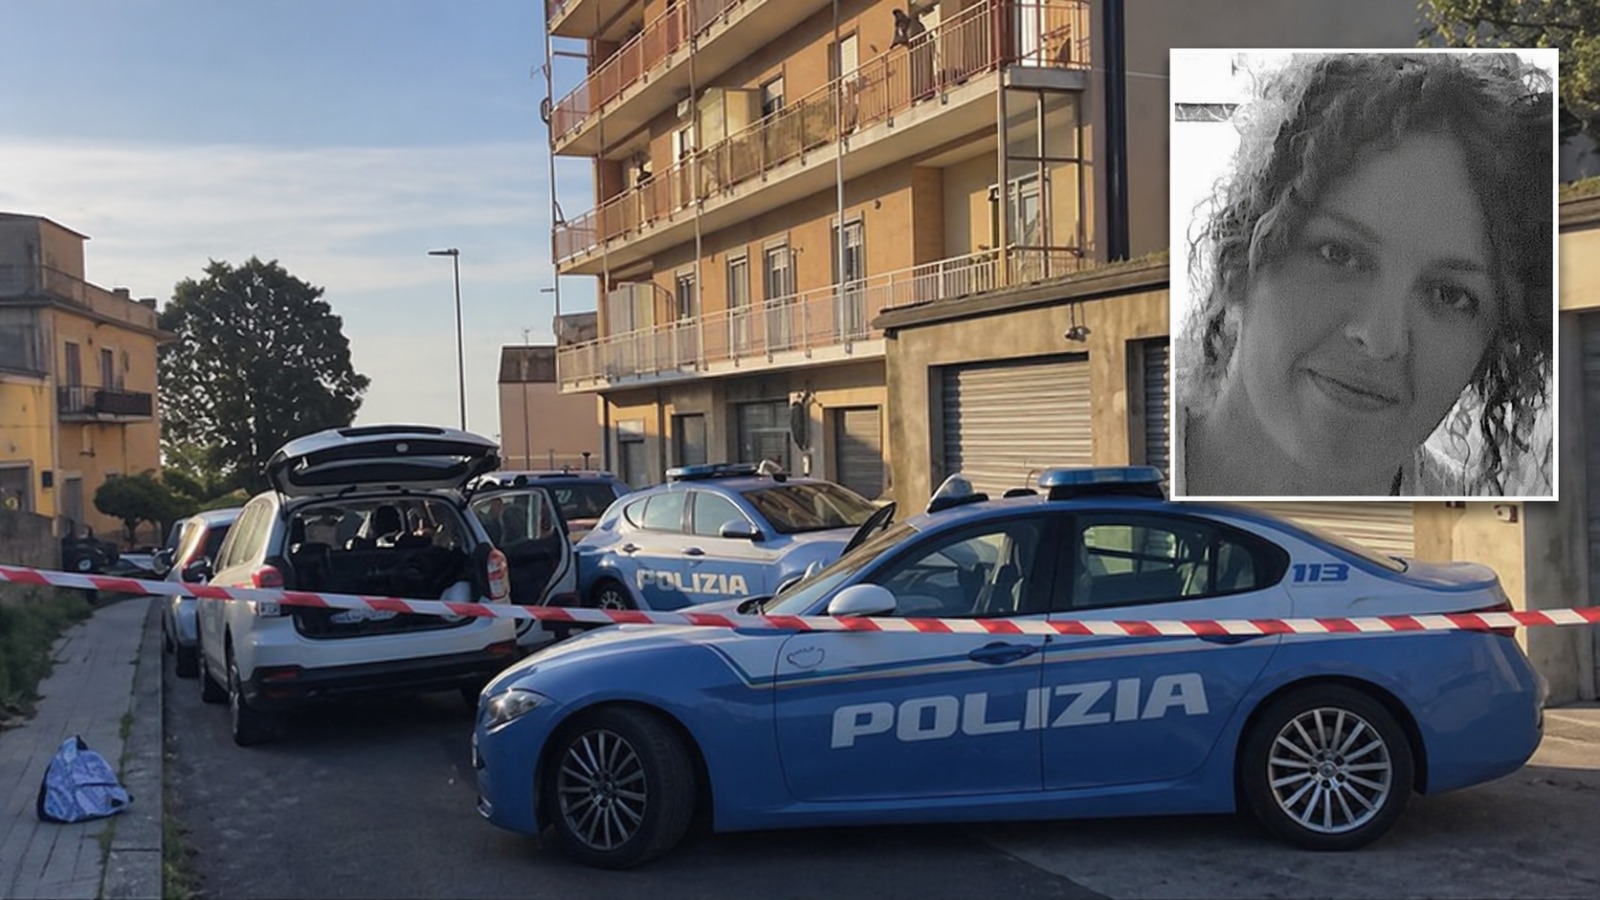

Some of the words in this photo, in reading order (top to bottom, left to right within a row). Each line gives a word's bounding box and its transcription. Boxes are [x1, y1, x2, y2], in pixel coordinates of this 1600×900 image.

[636, 568, 749, 596] POLIZIA
[1292, 563, 1350, 583] 113
[830, 672, 1210, 749] POLIZIA
